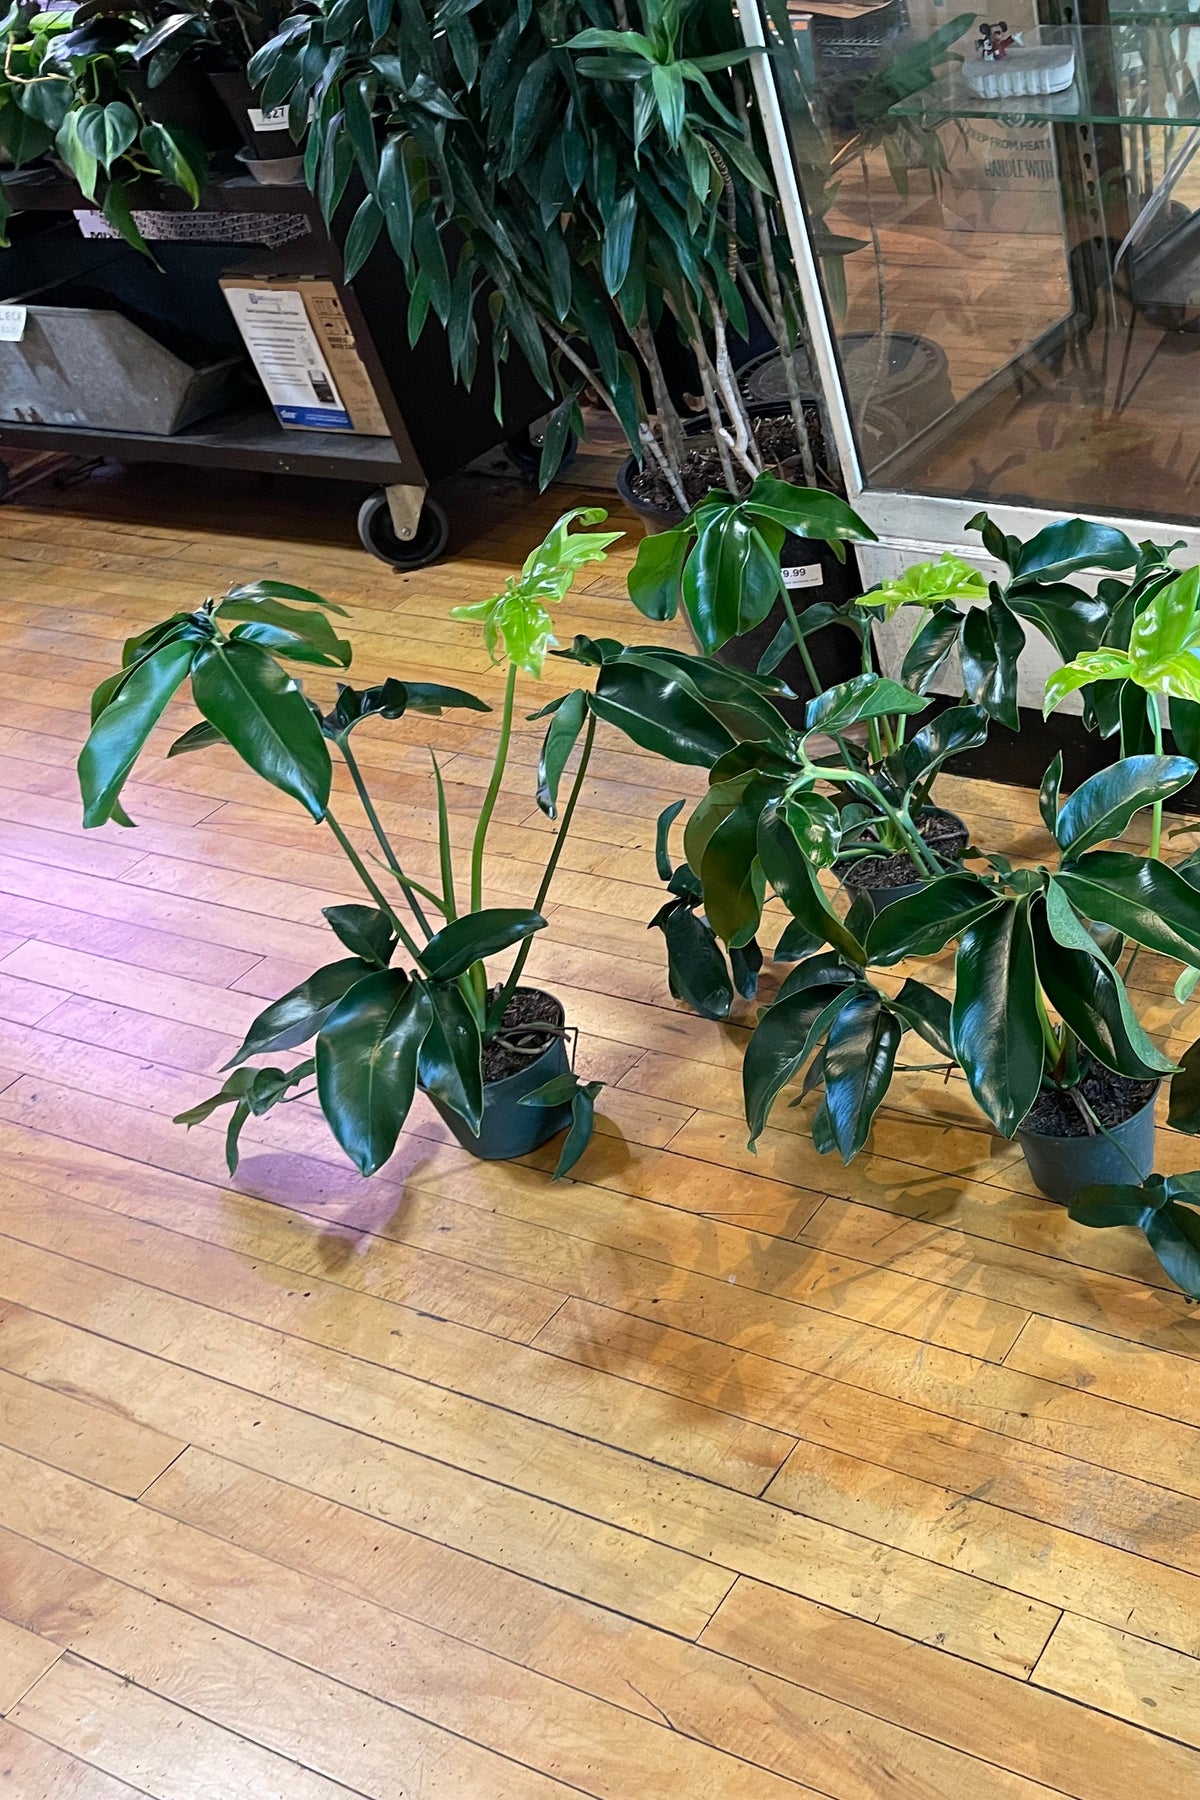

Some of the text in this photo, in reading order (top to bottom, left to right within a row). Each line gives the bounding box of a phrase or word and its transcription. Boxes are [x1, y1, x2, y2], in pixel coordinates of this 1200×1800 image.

[990, 136, 1019, 150] FROM
[1020, 139, 1045, 151] HEAT
[984, 158, 1054, 179] HANDLE WITH
[780, 567, 806, 578] 9.99
